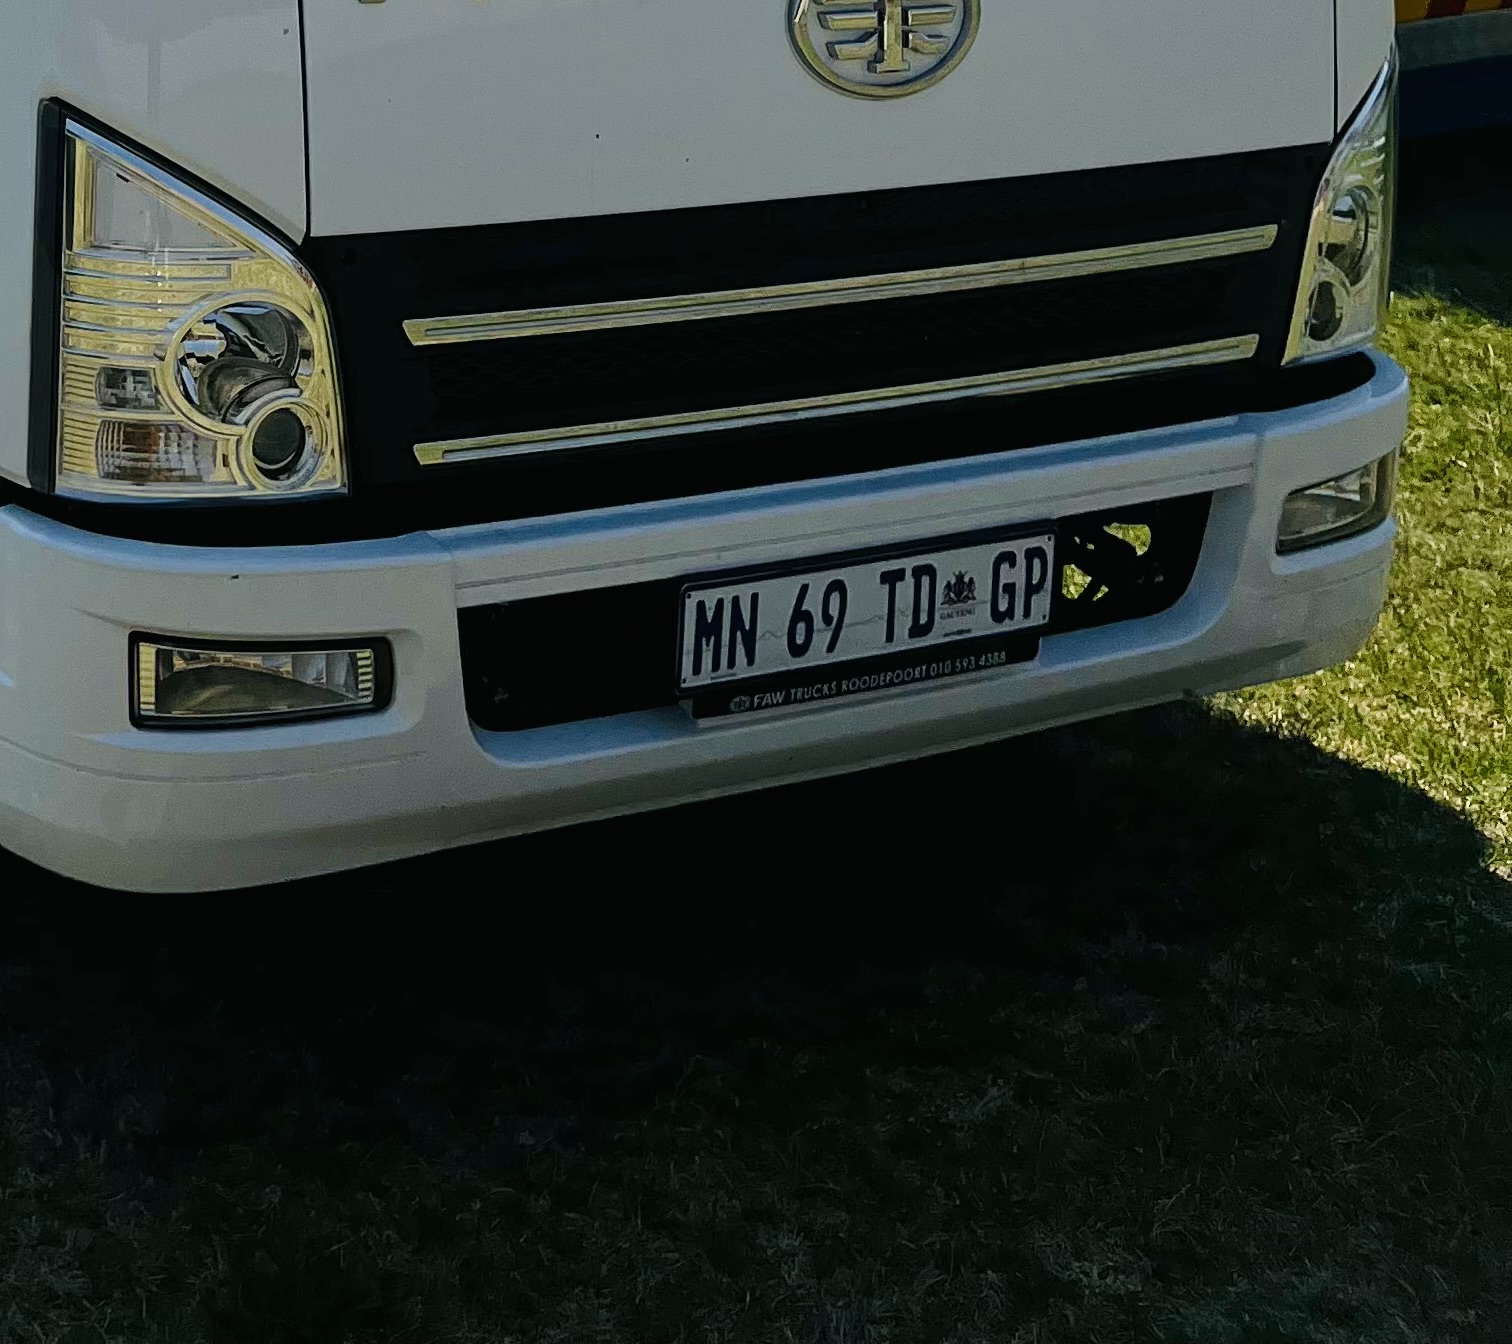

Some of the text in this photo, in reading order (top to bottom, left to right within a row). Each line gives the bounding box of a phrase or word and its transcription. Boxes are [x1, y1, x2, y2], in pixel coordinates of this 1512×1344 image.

[692, 545, 1049, 677] MN 69 TD GP
[753, 690, 786, 708] FAW
[790, 681, 837, 701] TRUCKS
[841, 664, 927, 692] ROODEPOORT
[930, 660, 952, 677] 010
[955, 656, 976, 672] 593
